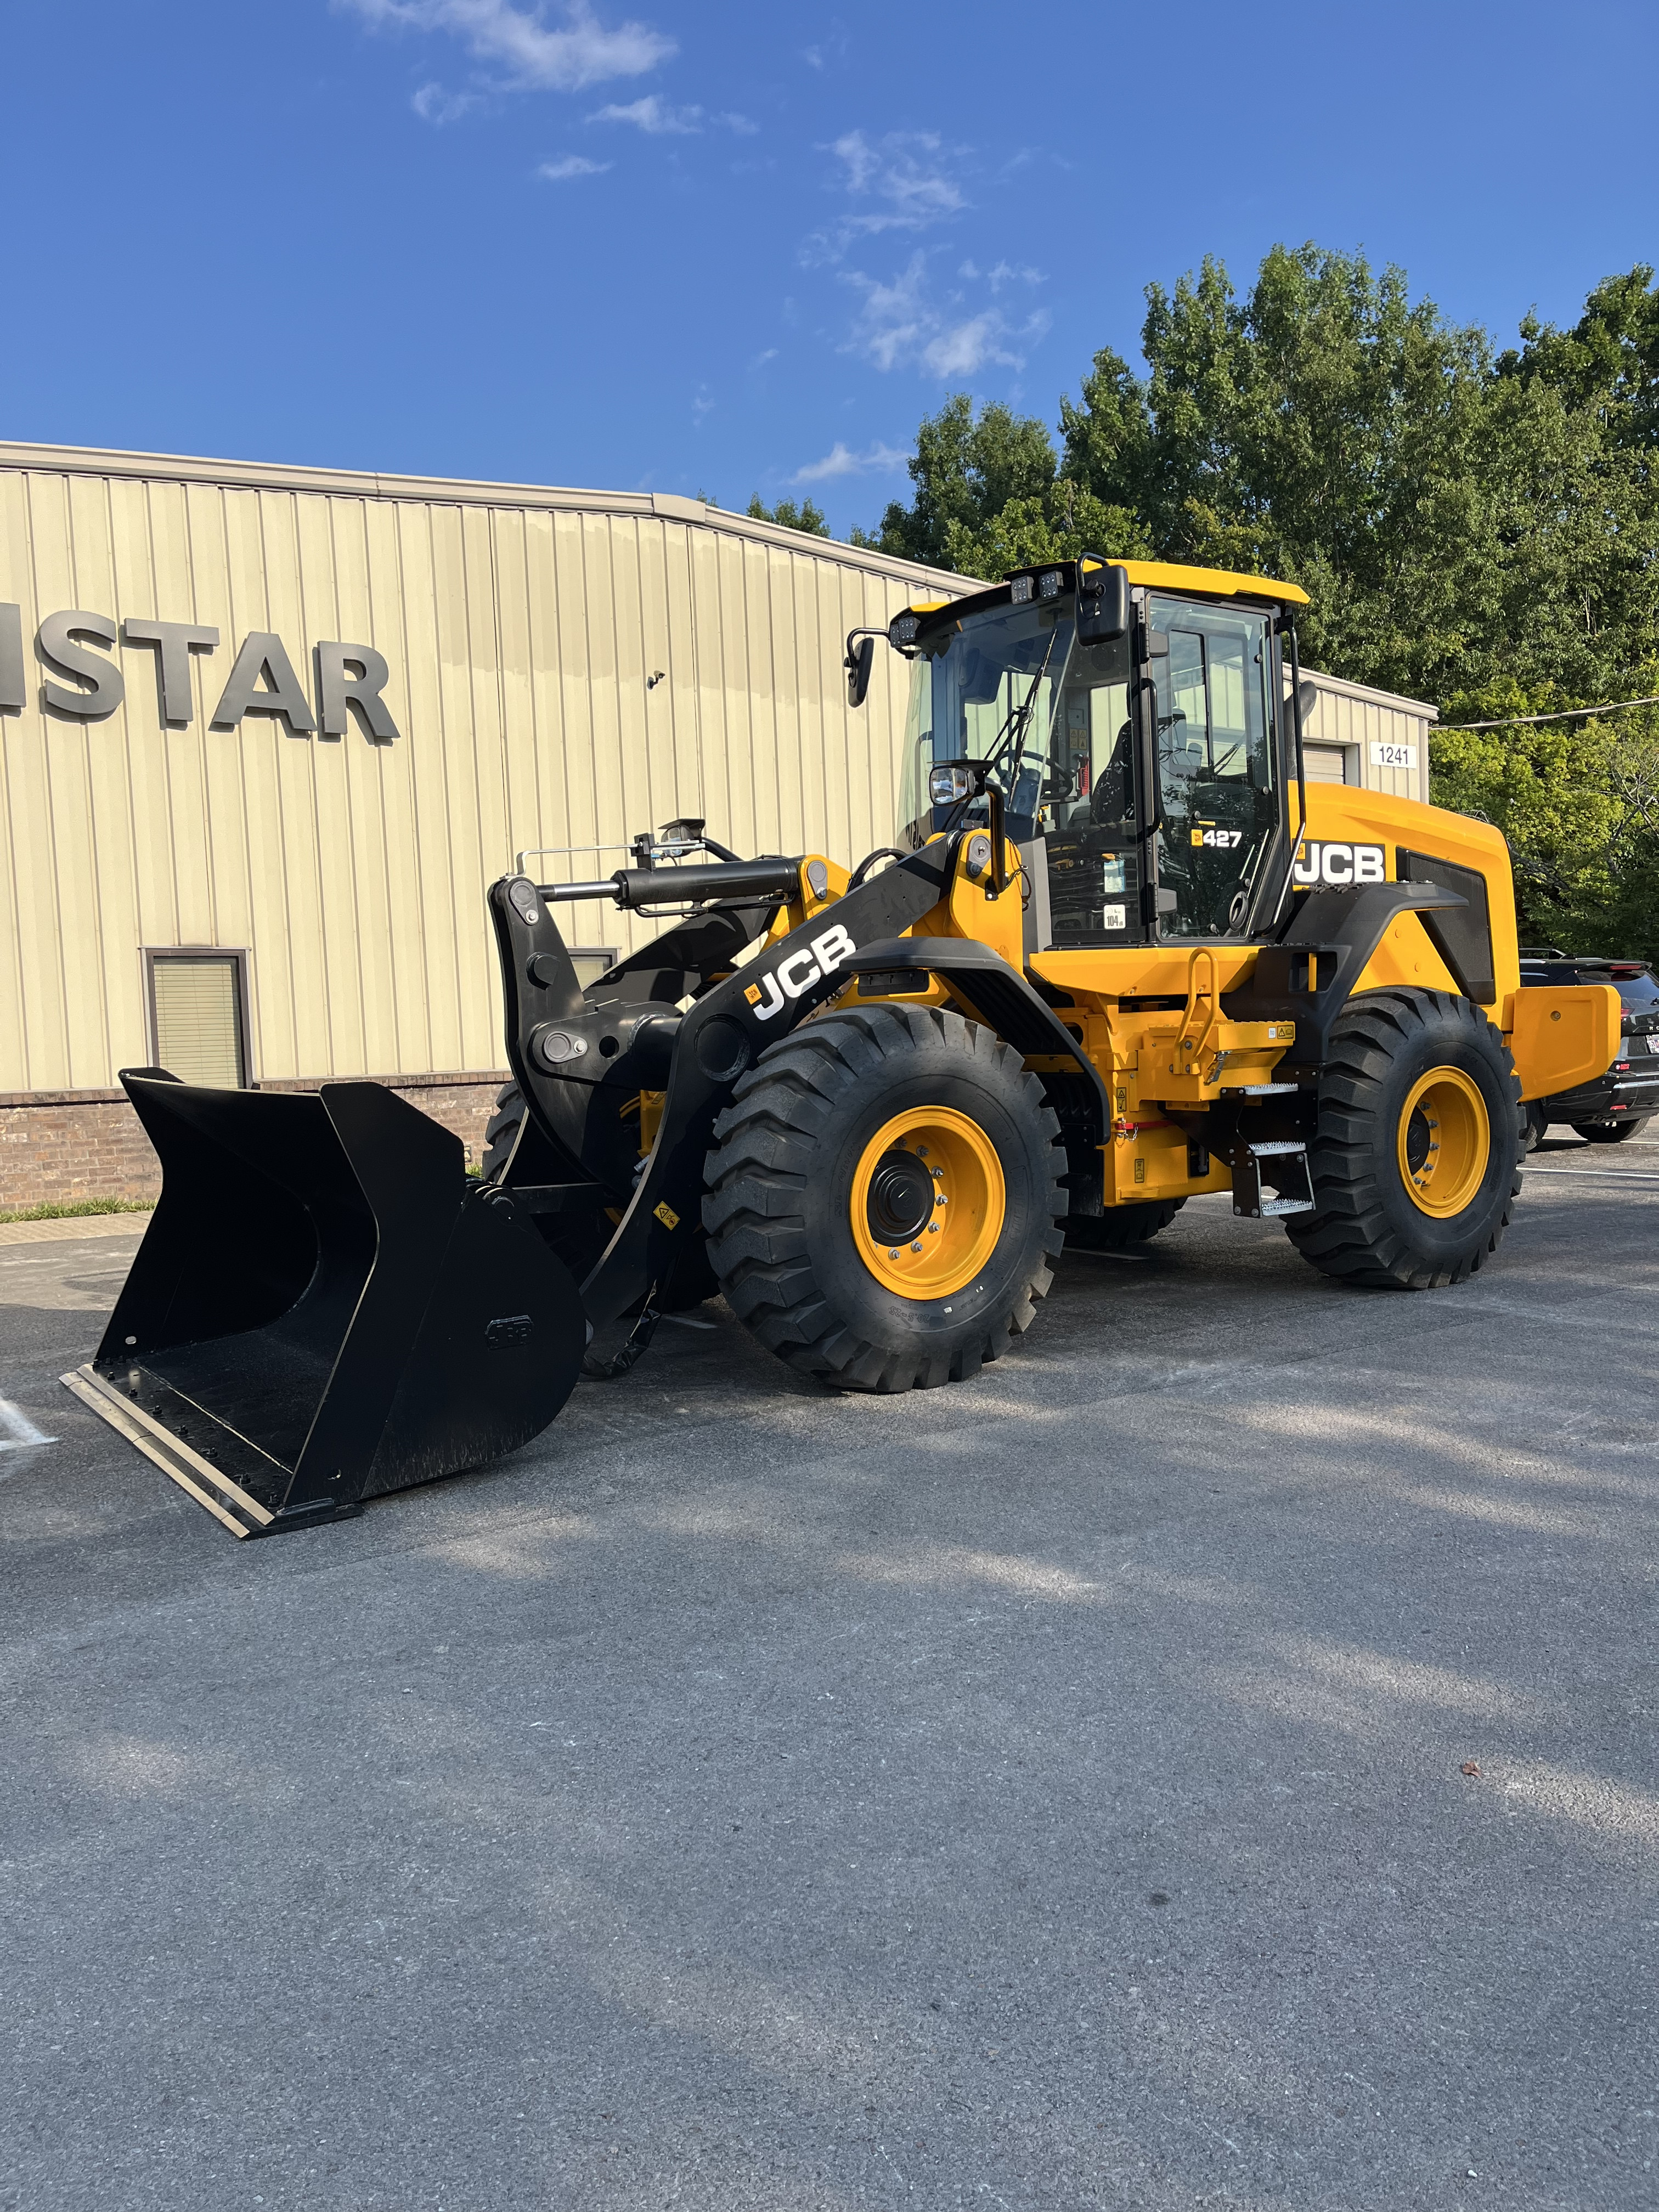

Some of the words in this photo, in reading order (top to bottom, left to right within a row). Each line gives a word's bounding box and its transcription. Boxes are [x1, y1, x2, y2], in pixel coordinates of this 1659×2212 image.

[1379, 745, 1408, 765] 1241
[1203, 830, 1242, 848] 427
[1294, 843, 1385, 883] JCB
[1106, 915, 1119, 927] 104
[753, 924, 856, 1020] JCB
